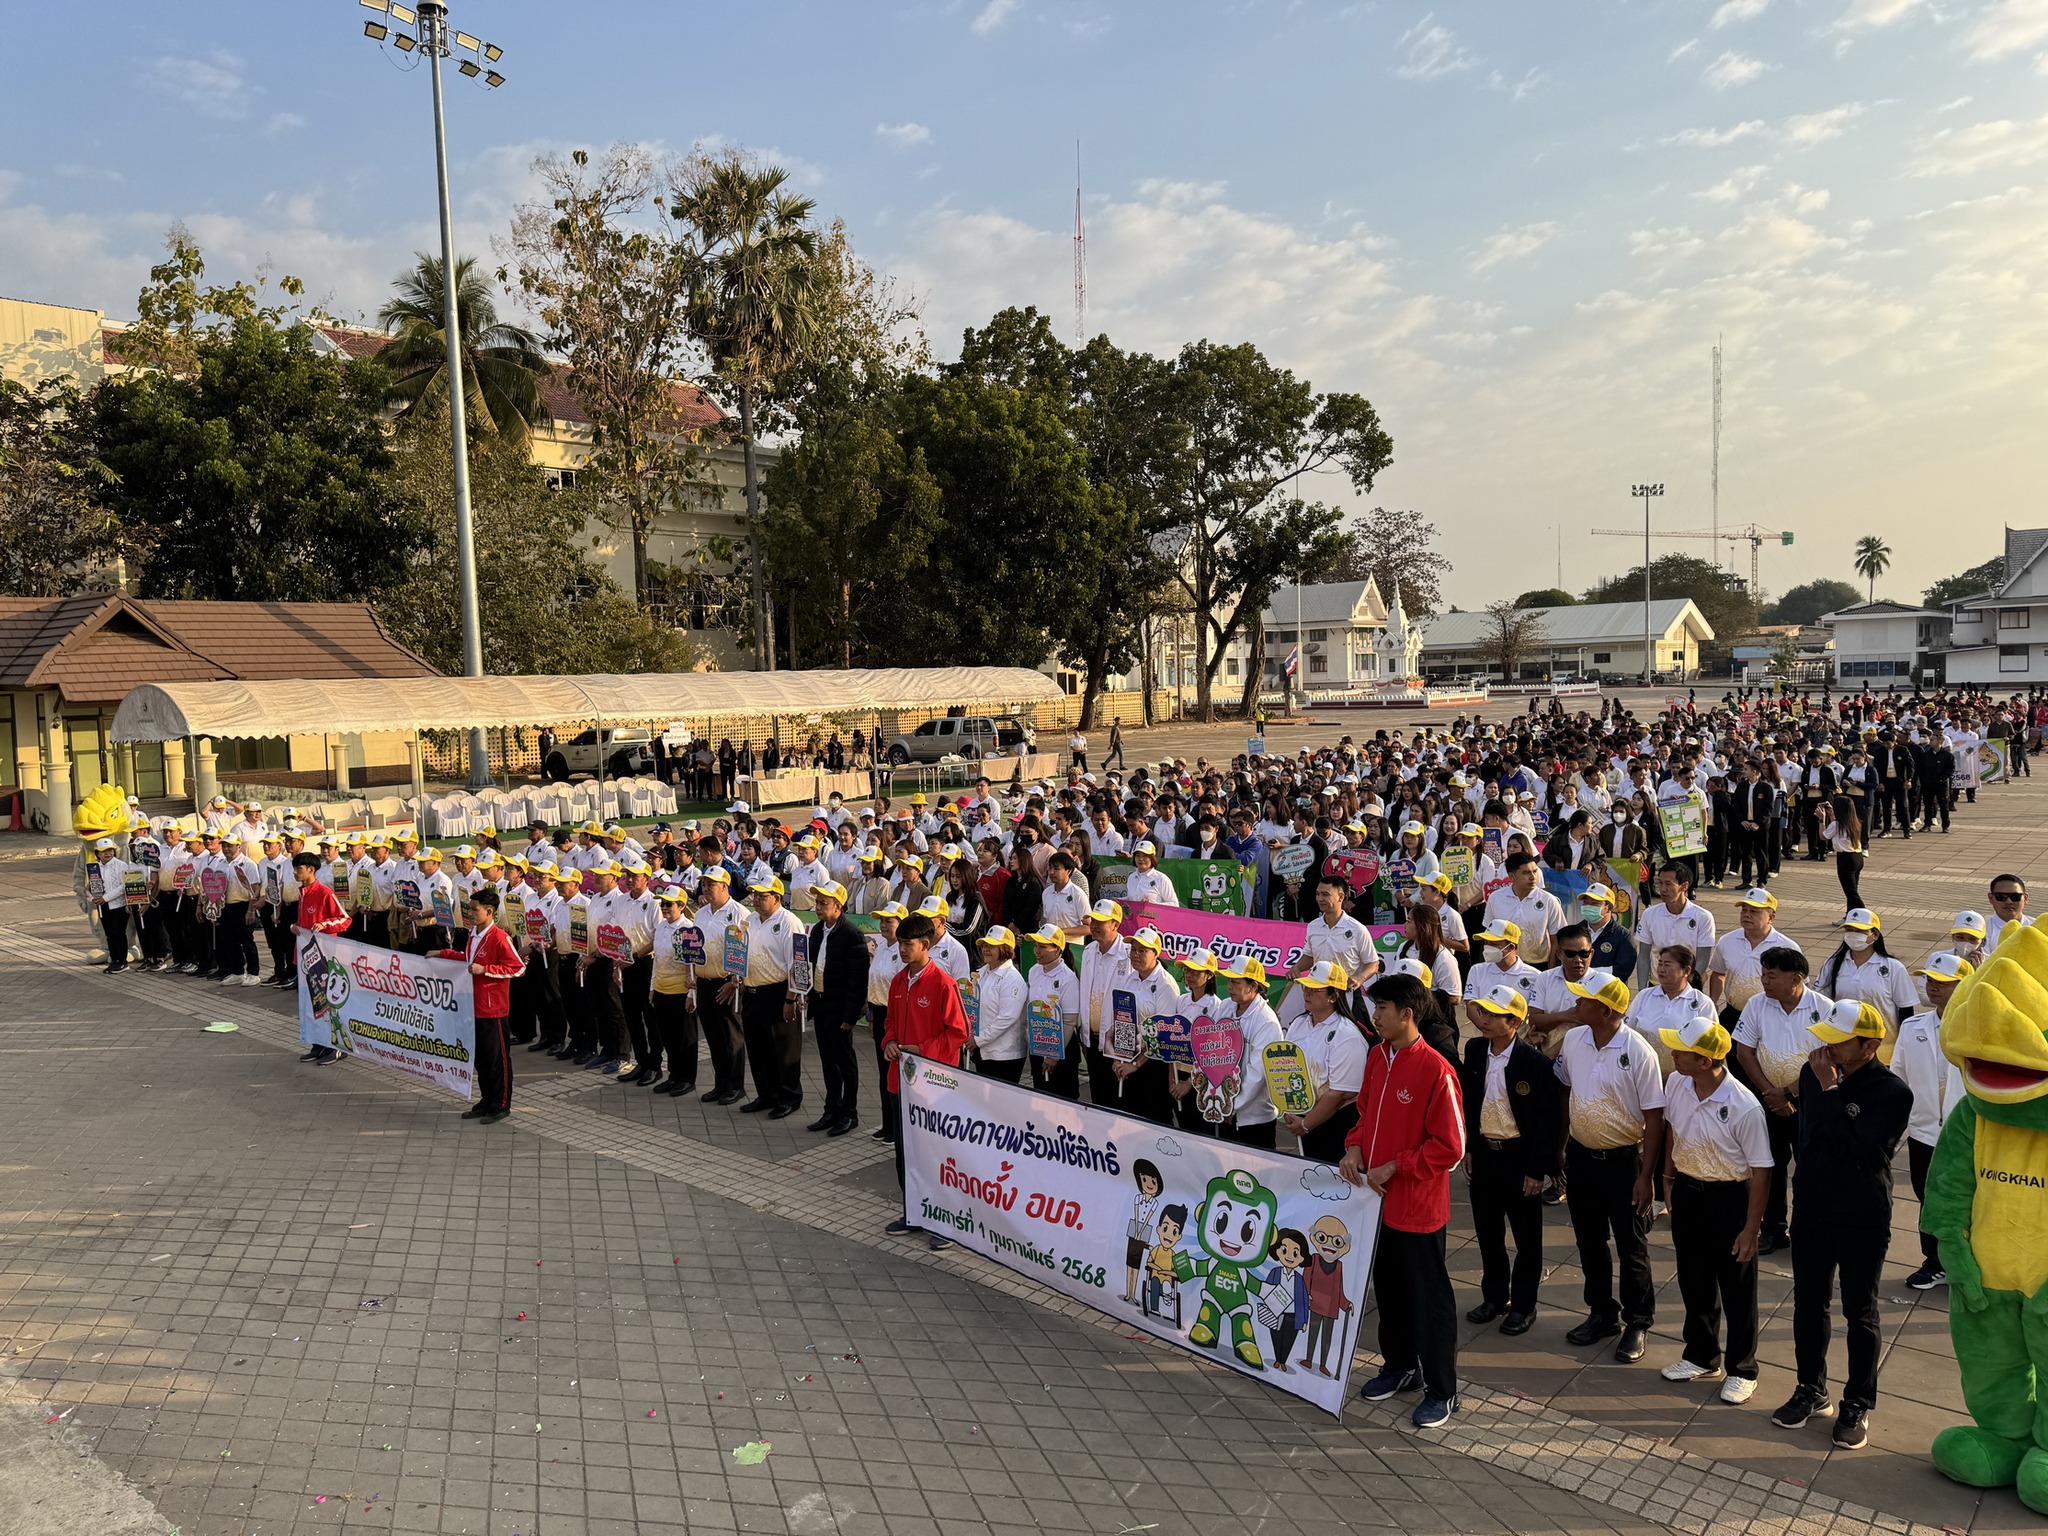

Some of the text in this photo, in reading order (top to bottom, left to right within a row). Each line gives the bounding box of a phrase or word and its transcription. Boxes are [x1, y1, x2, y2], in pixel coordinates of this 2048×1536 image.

[351, 954, 418, 999] เลือกตั้ง
[414, 976, 459, 1012] อบจ.
[374, 998, 435, 1033] ร่วมกันใช้สิทธิ
[349, 1018, 469, 1063] ชาวหนองคายพร้อมใจไปเลือกตั้ง
[405, 1057, 420, 1067] 2568
[908, 1102, 1121, 1177] ชาวหนองคายพร้อมใช้สิทธิ
[940, 1157, 1084, 1231] เลือกตั้ง อบจ.
[920, 1197, 1107, 1289] วันเสาร์ที่ 1 กุมภาพันธ์ 2568
[1214, 1275, 1240, 1293] ECT
[1218, 1269, 1237, 1280] SMART
